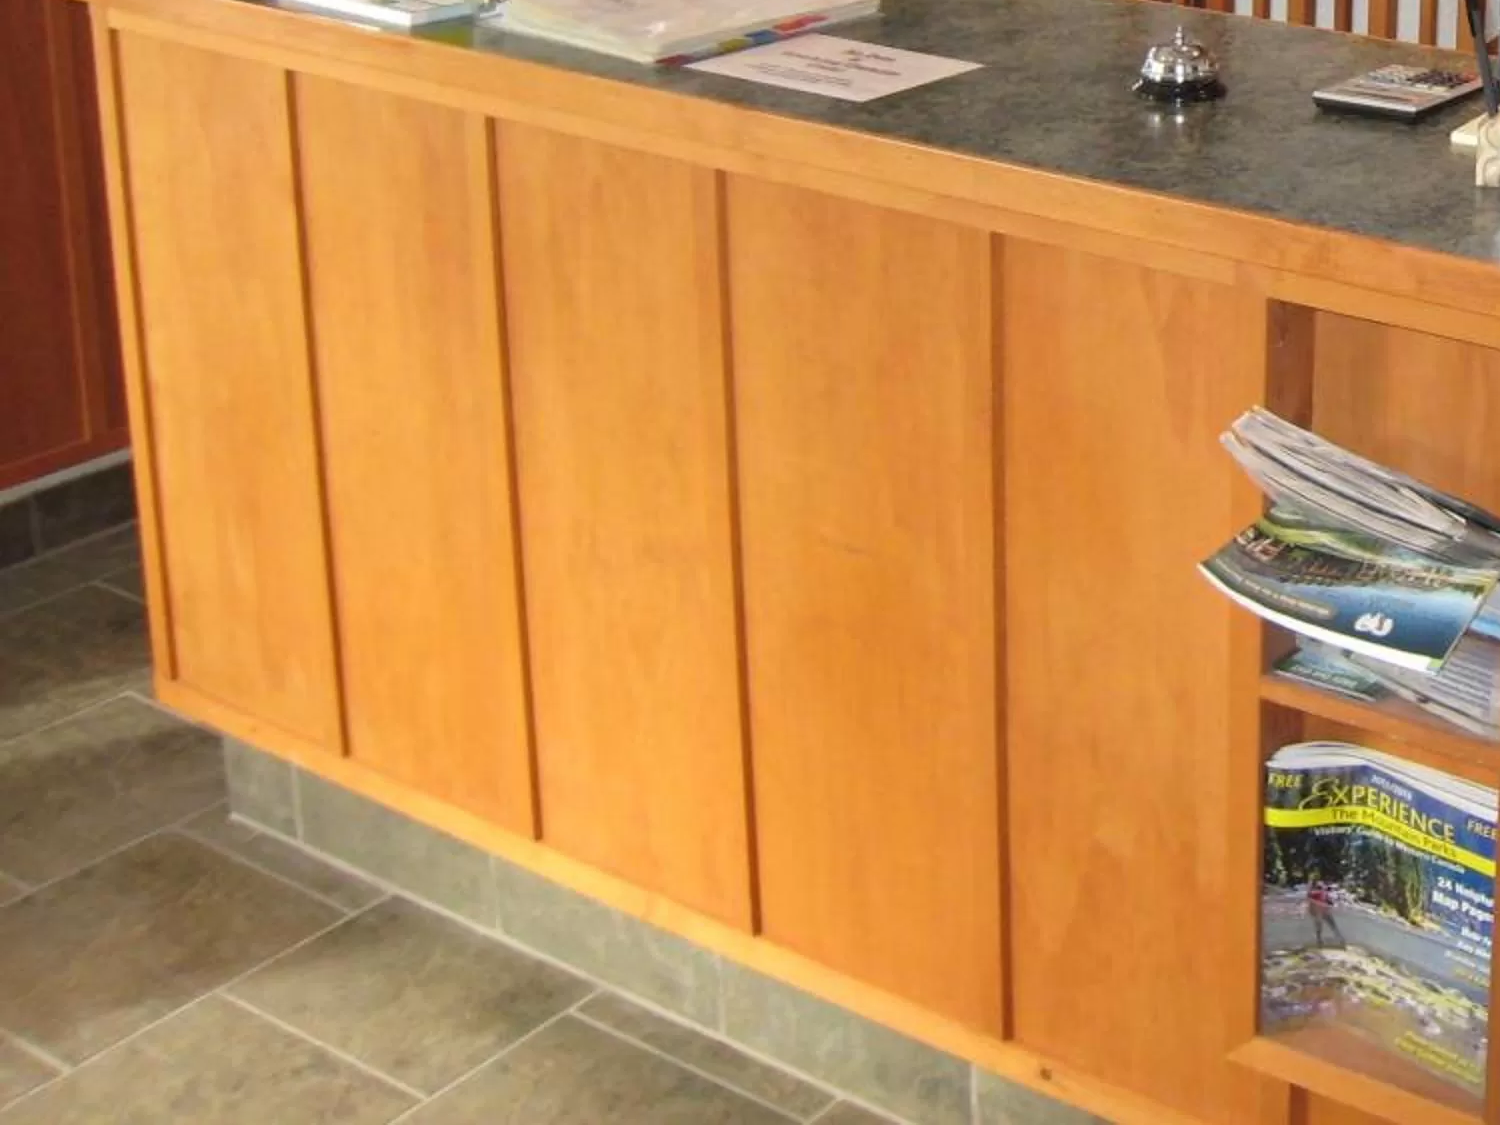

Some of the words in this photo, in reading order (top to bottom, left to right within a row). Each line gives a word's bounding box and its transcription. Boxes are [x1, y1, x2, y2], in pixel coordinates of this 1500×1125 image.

[1267, 773, 1302, 789] FREE
[1299, 777, 1457, 844] EXPERIENCE
[1331, 807, 1358, 821] The
[1466, 818, 1498, 841] FREE
